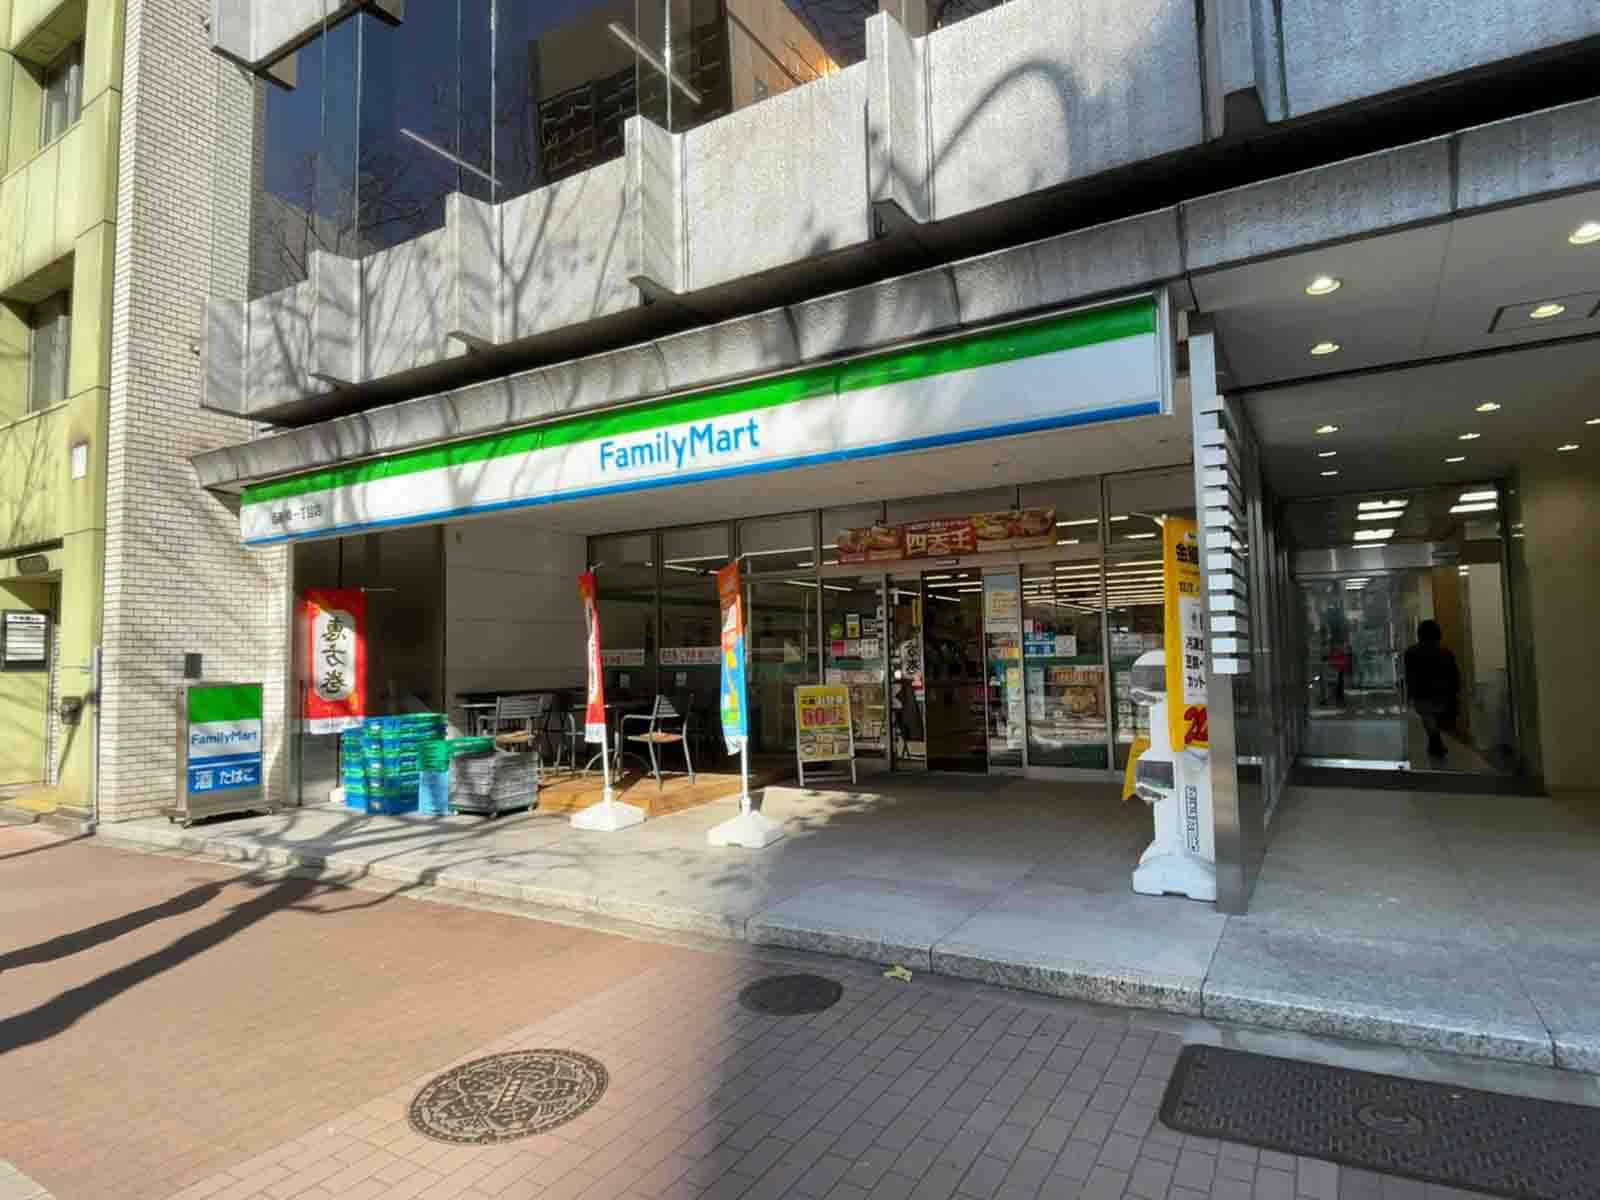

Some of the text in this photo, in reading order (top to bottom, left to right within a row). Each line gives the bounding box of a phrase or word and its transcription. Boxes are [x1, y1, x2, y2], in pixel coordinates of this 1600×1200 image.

[600, 416, 760, 472] FamilyMart
[906, 528, 972, 555] 四天王
[191, 730, 257, 745] FamilyMart
[194, 768, 256, 790] 酒 たばこ
